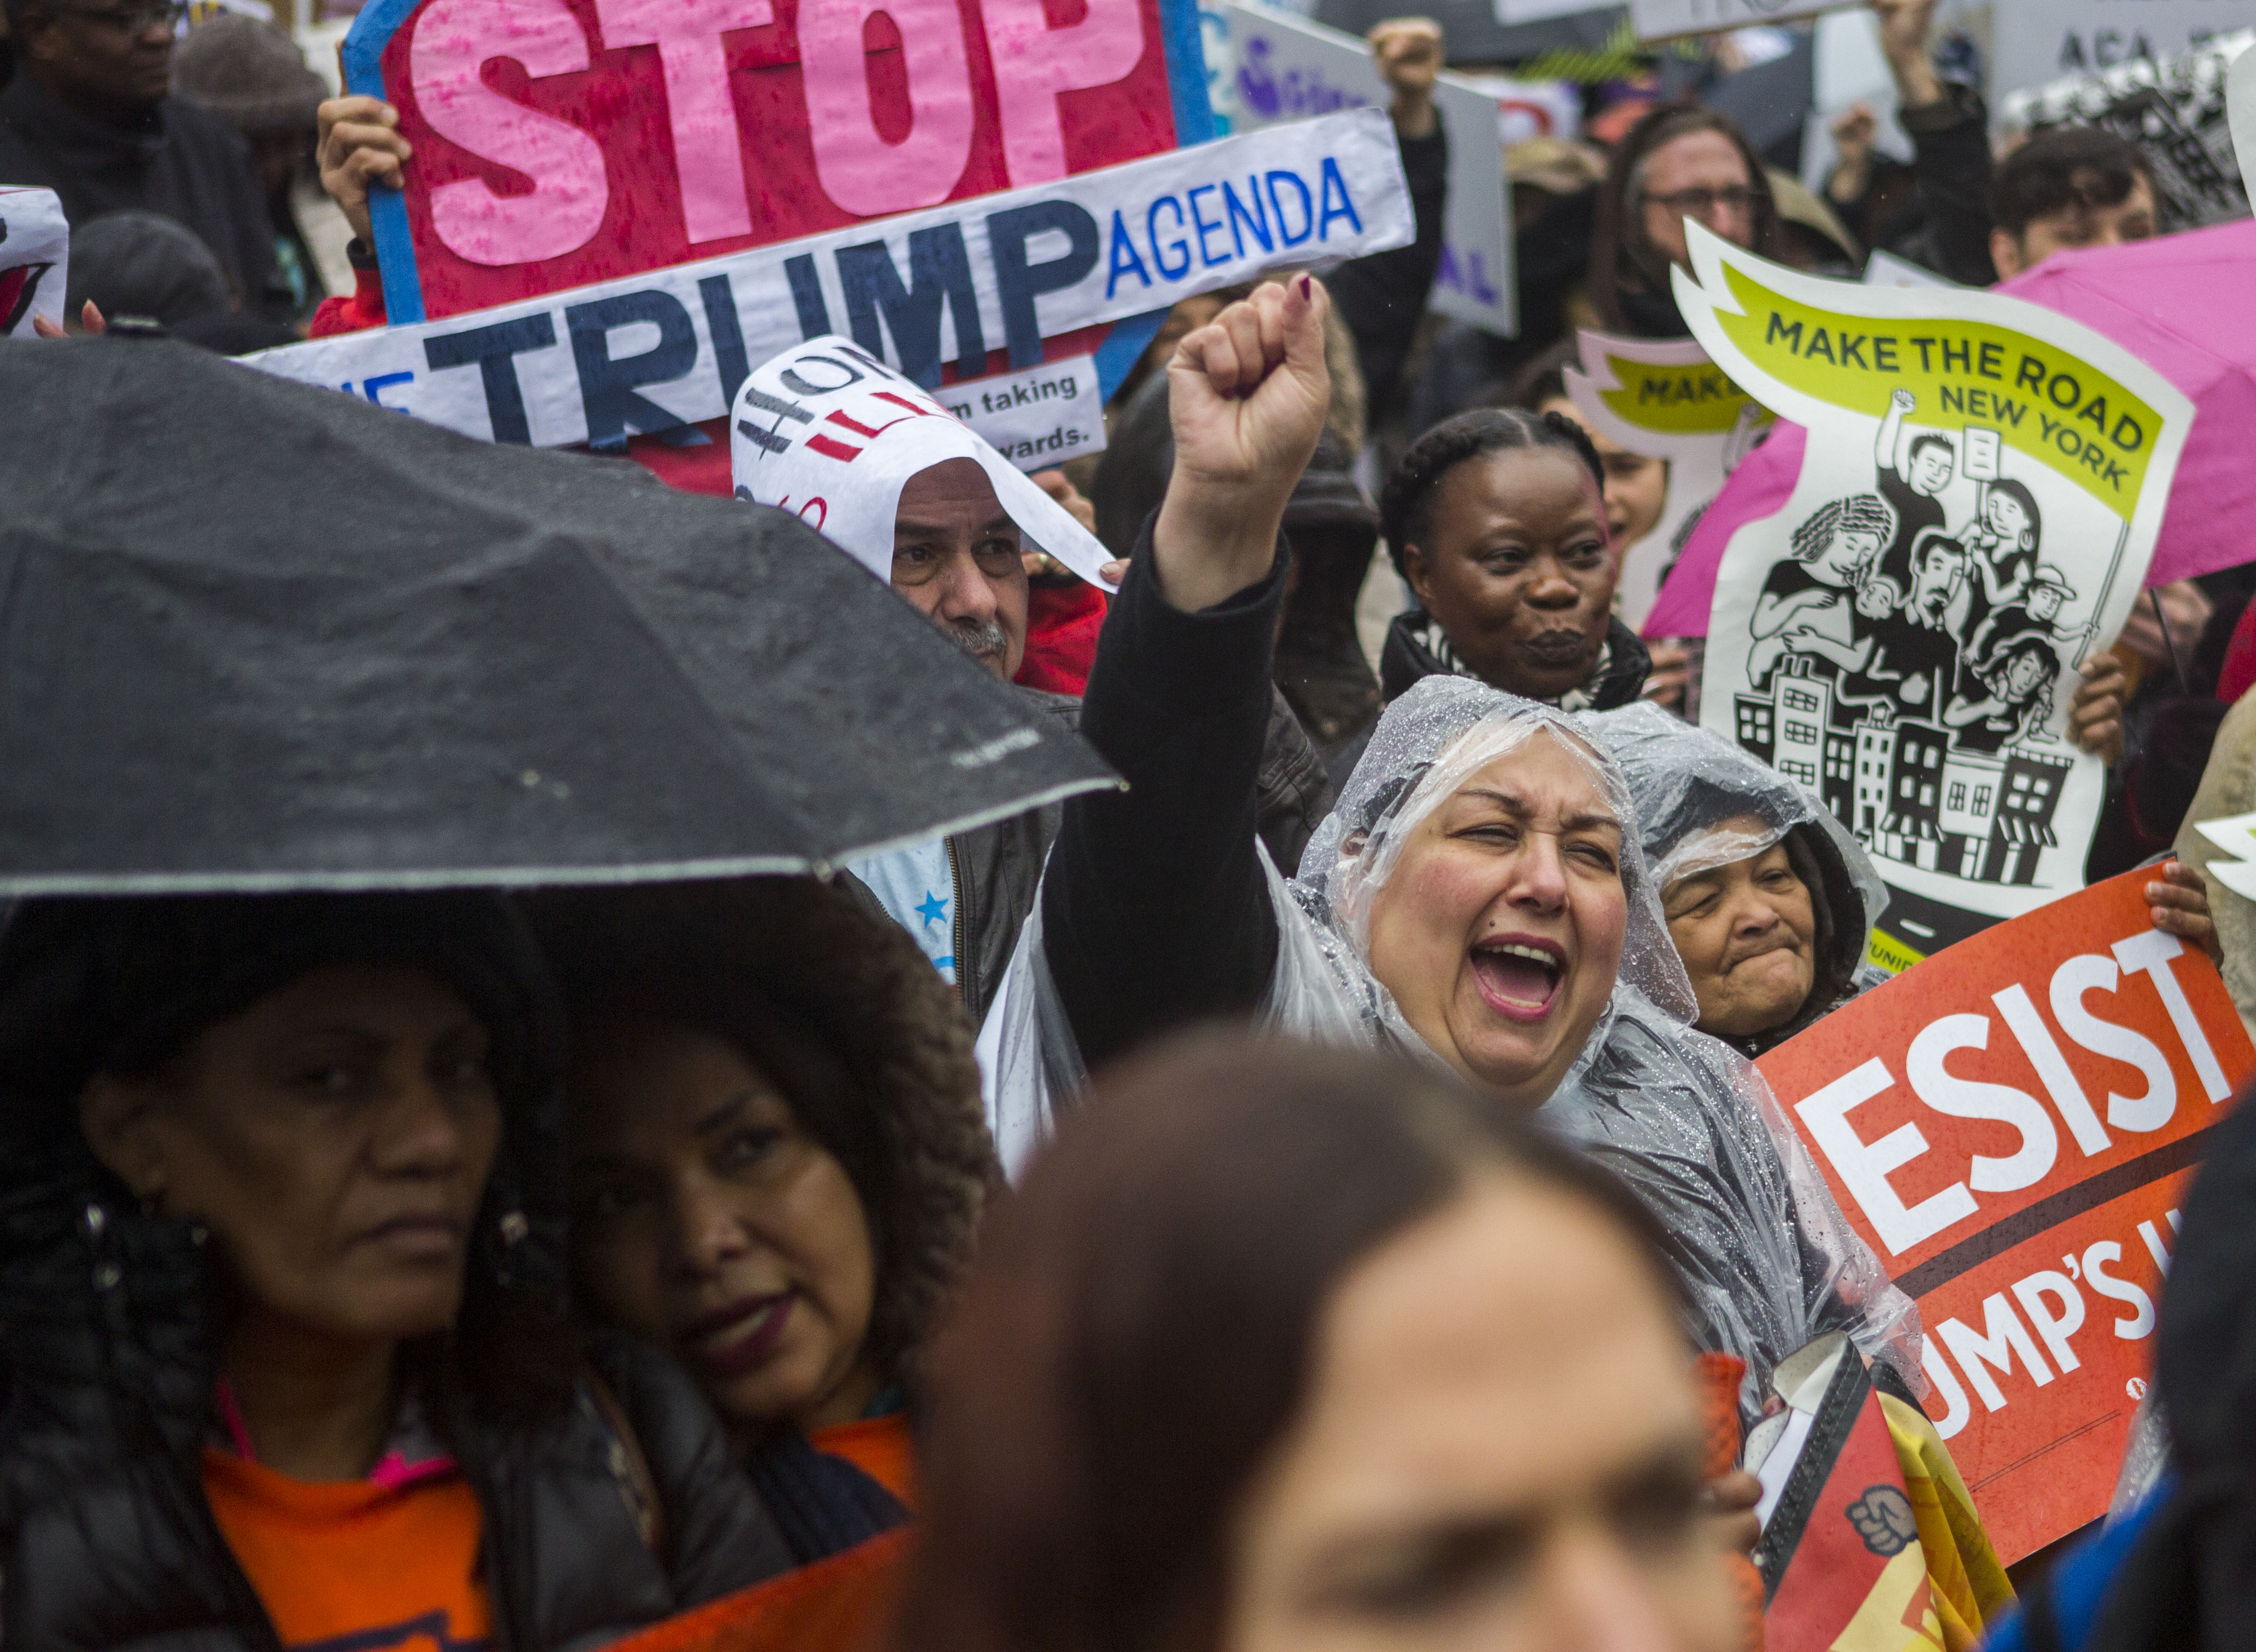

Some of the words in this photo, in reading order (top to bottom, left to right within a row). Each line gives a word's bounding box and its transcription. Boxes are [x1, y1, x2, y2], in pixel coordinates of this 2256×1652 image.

[411, 0, 1145, 266] STOP
[424, 200, 1101, 455] TRUMP
[1104, 157, 1363, 300] AGENDA
[981, 377, 1078, 413] taking
[1764, 312, 1900, 372] MAKE
[1909, 337, 2005, 380] THE
[2015, 354, 2144, 453] ROAD
[1940, 385, 2028, 429] NEW
[2040, 413, 2132, 493] YORK
[1793, 929, 2233, 1258] ESIST
